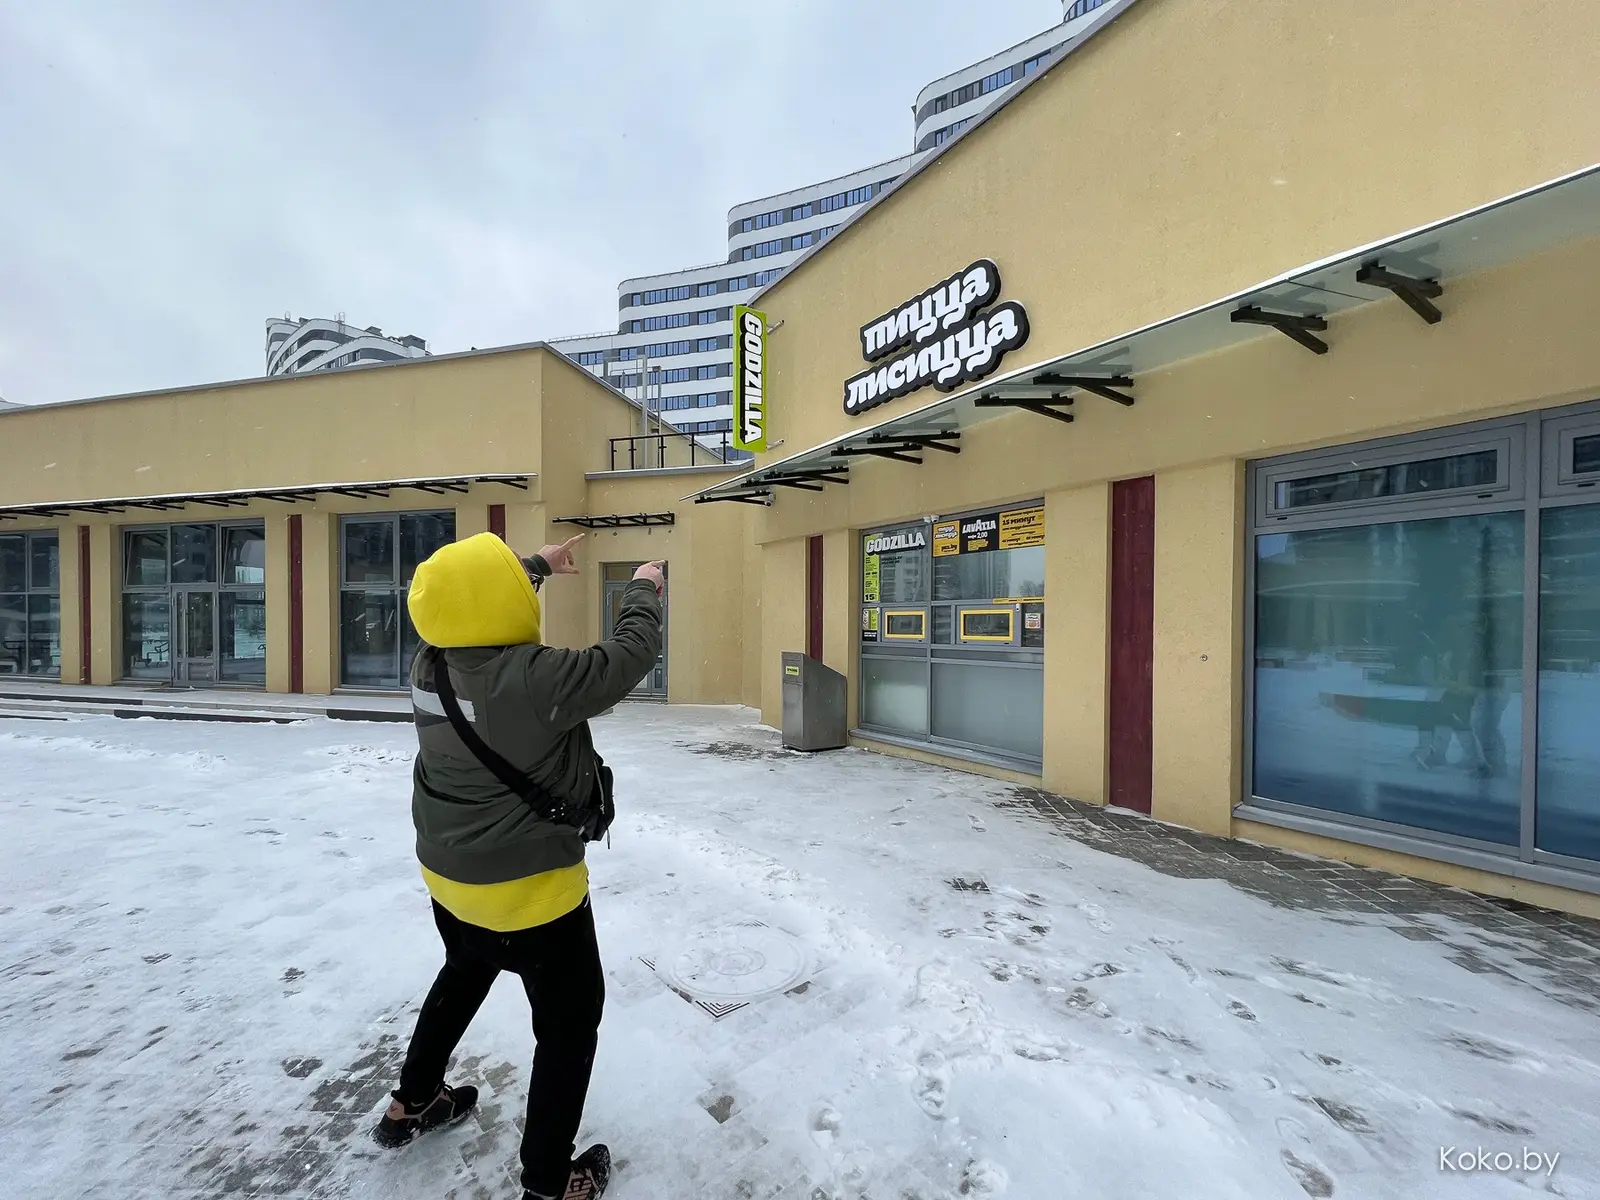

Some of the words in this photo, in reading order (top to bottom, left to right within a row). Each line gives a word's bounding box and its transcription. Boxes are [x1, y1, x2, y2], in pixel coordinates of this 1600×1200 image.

[864, 267, 990, 355] пицца
[743, 312, 763, 444] GODZILLA
[846, 309, 1019, 409] лисицца
[866, 532, 926, 553] GODZILLA
[962, 519, 996, 534] LAVAZZA
